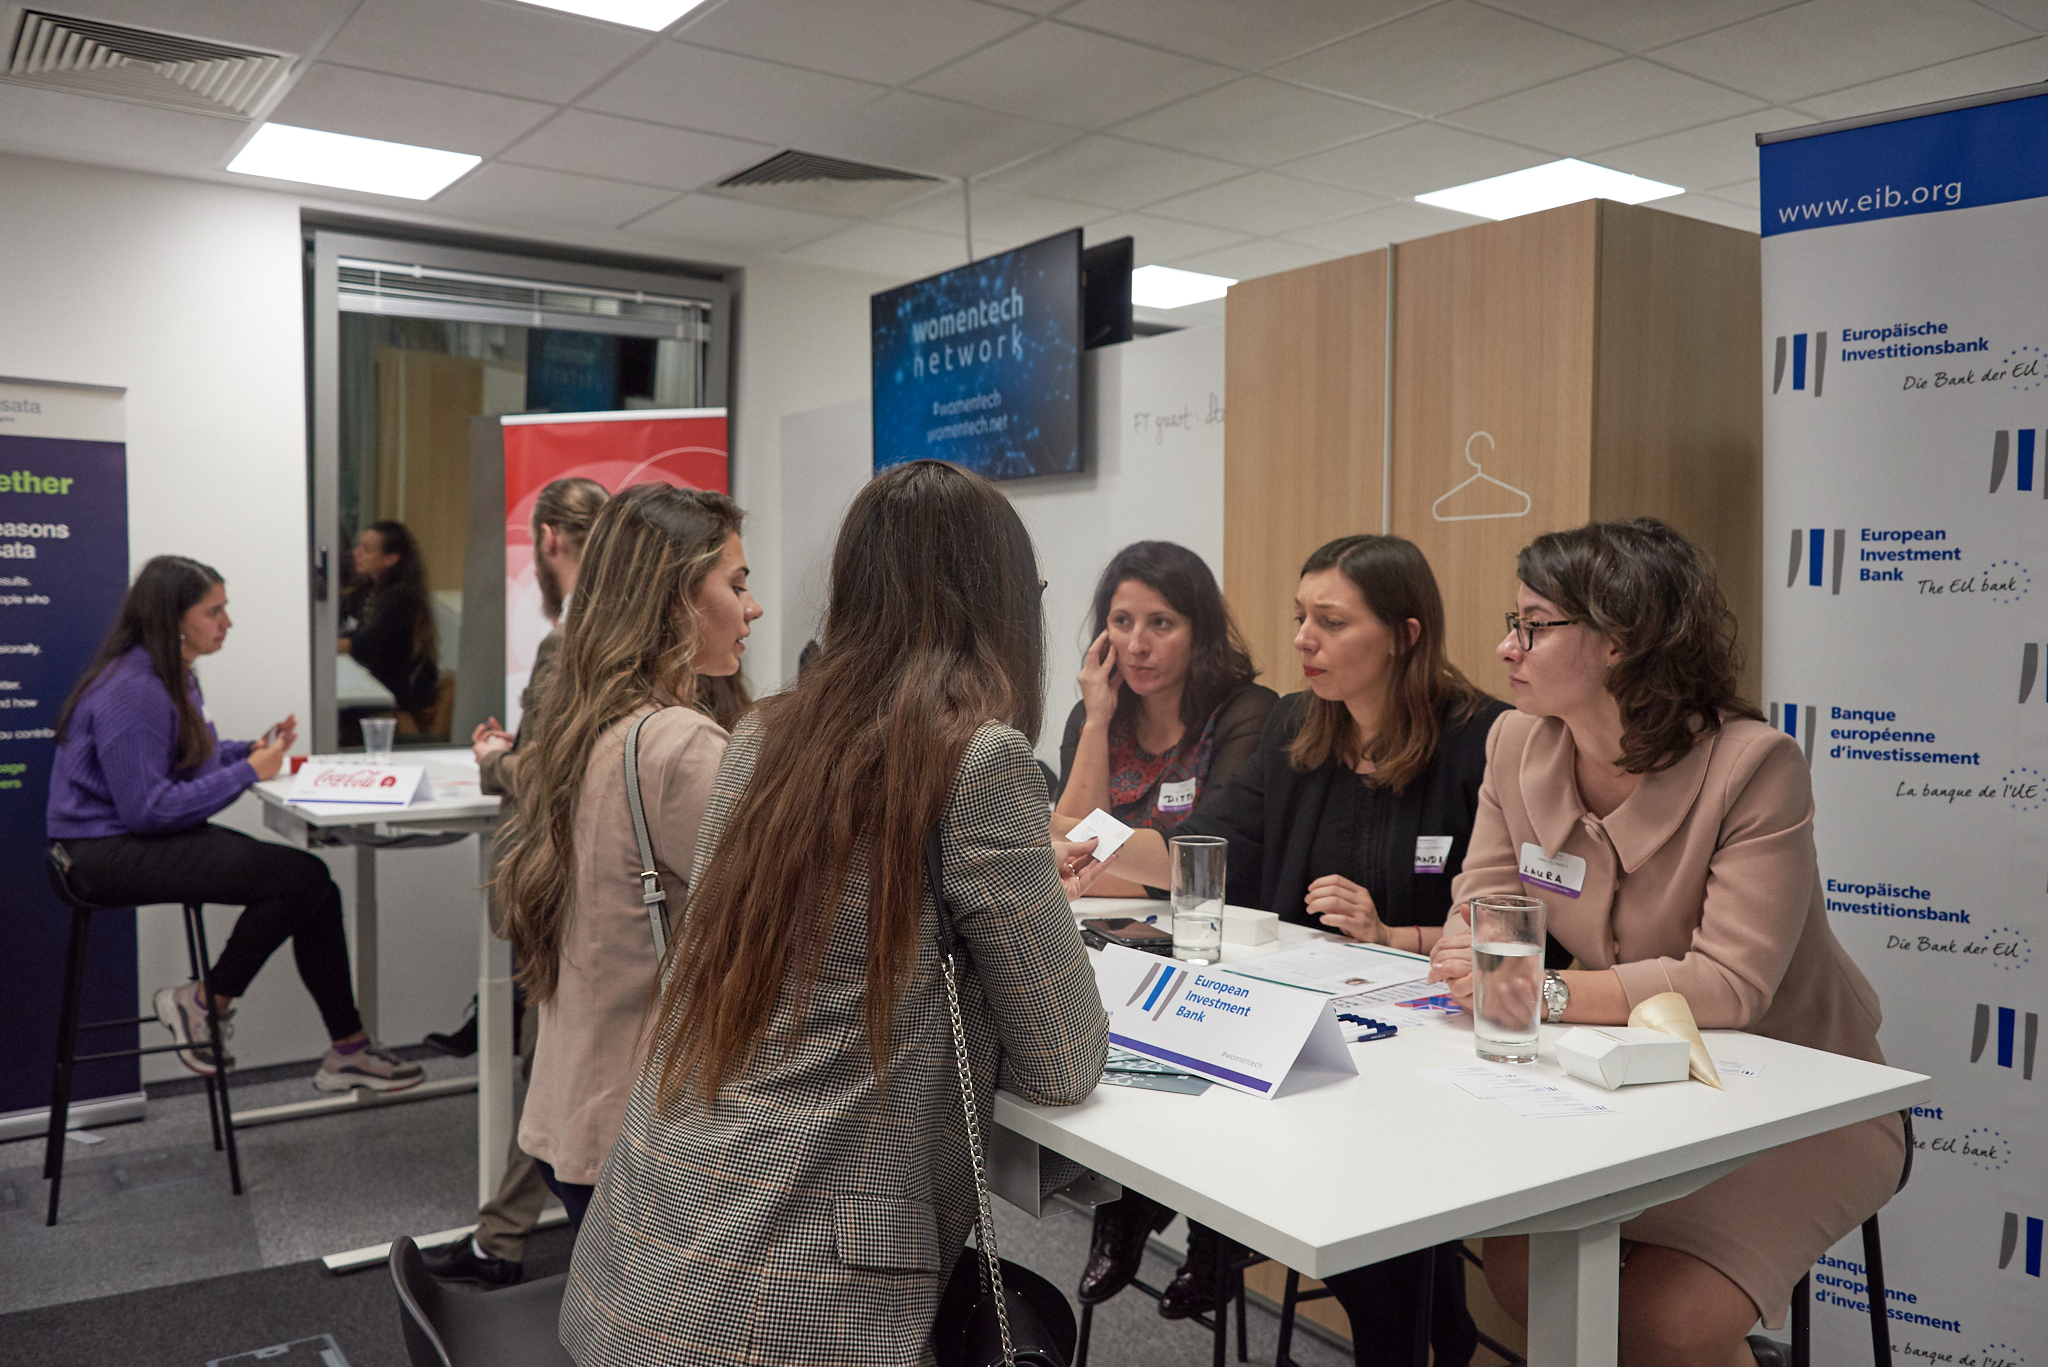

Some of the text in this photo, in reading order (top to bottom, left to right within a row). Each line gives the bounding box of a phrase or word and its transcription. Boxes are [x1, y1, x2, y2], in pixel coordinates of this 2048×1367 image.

[1778, 181, 1962, 224] www.eib.org
[912, 285, 1024, 344] womentech
[1842, 321, 1949, 343] Europäische
[913, 323, 1024, 378] network
[1841, 337, 1989, 362] Investitionsbank
[1902, 360, 2039, 391] Die Bank der EU
[0, 522, 70, 539] asons
[1860, 528, 1947, 545] European
[1860, 547, 1961, 562] Investment
[1859, 567, 1904, 582] Bank
[1918, 576, 2017, 595] The EU bank
[1830, 706, 1896, 724] Banque
[1830, 727, 1936, 745] européenne
[1830, 745, 1980, 766] d'investissement
[1895, 781, 1917, 798] La
[1922, 782, 1972, 804] banque
[1978, 785, 1996, 799] de
[1523, 865, 1562, 884] LAURA
[1827, 878, 1931, 900] Europäische
[1826, 898, 1971, 924] Investitionsbank
[1887, 934, 2020, 958] Die Bank der EU
[1194, 974, 1250, 999] European
[1176, 1005, 1207, 1023] Bank
[1185, 990, 1252, 1018] Investment
[1911, 1133, 1998, 1160] he EU bank
[1816, 1254, 1868, 1276] Banqu
[1815, 1273, 1918, 1304] europnne
[1815, 1289, 1962, 1334] d'invesssement
[1904, 1342, 1953, 1366] banque
[1959, 1354, 1976, 1367] de
